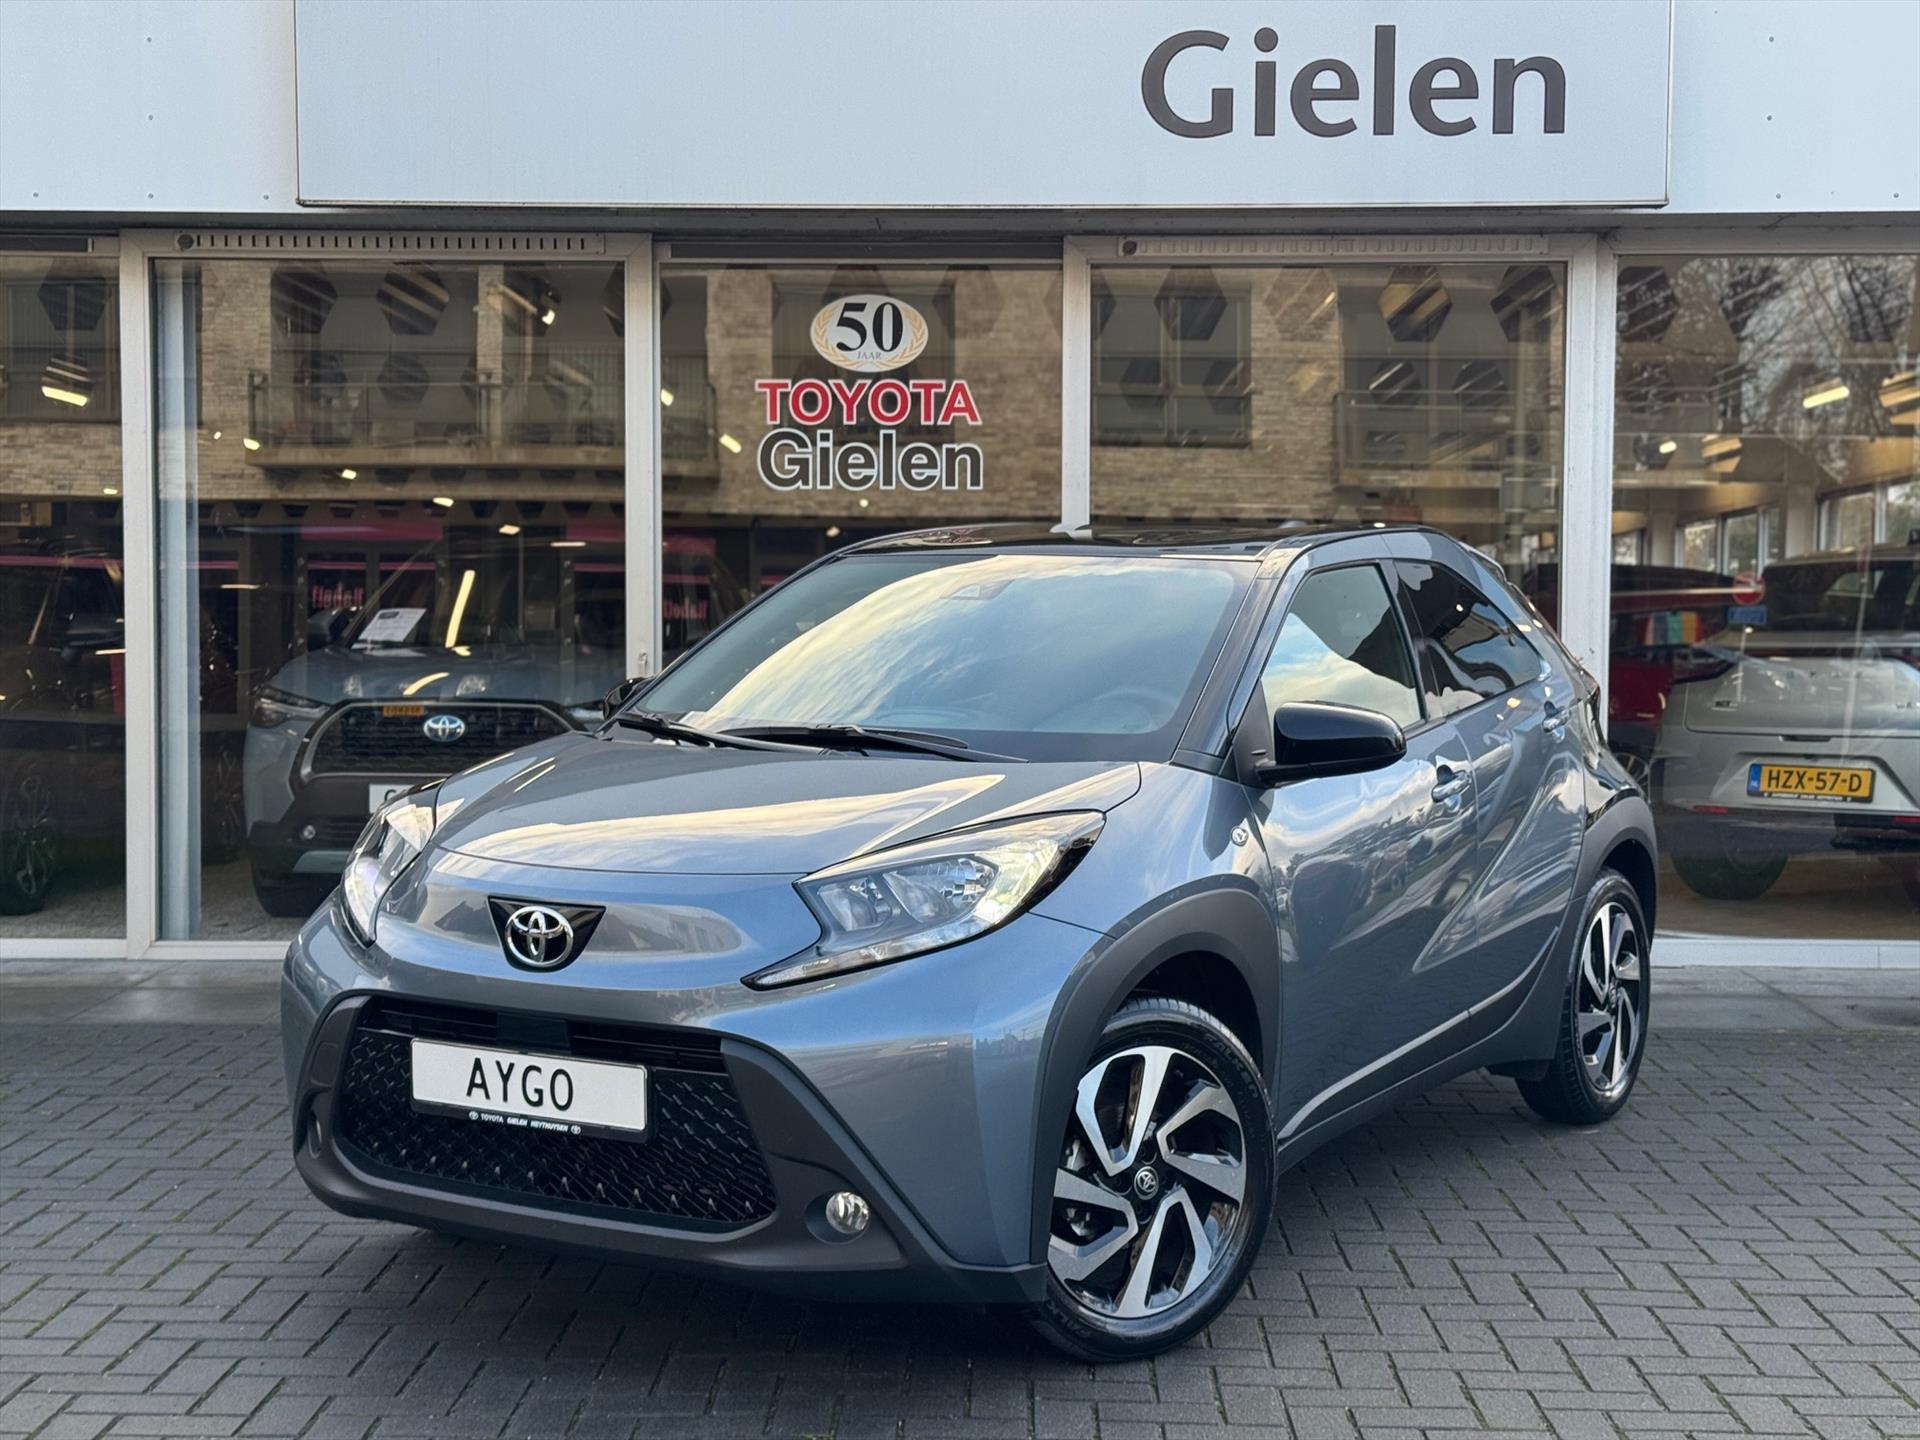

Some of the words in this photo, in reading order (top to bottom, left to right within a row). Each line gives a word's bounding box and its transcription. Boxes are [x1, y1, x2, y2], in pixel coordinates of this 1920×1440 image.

[1141, 25, 1566, 138] Gielen
[836, 302, 904, 352] 50
[857, 351, 882, 360] JAAR
[755, 378, 983, 425] TOYOTA
[757, 428, 984, 491] Gielen
[1767, 769, 1862, 793] HZX-57-D
[466, 1057, 573, 1111] AYGO
[480, 1112, 504, 1123] TOYOTA
